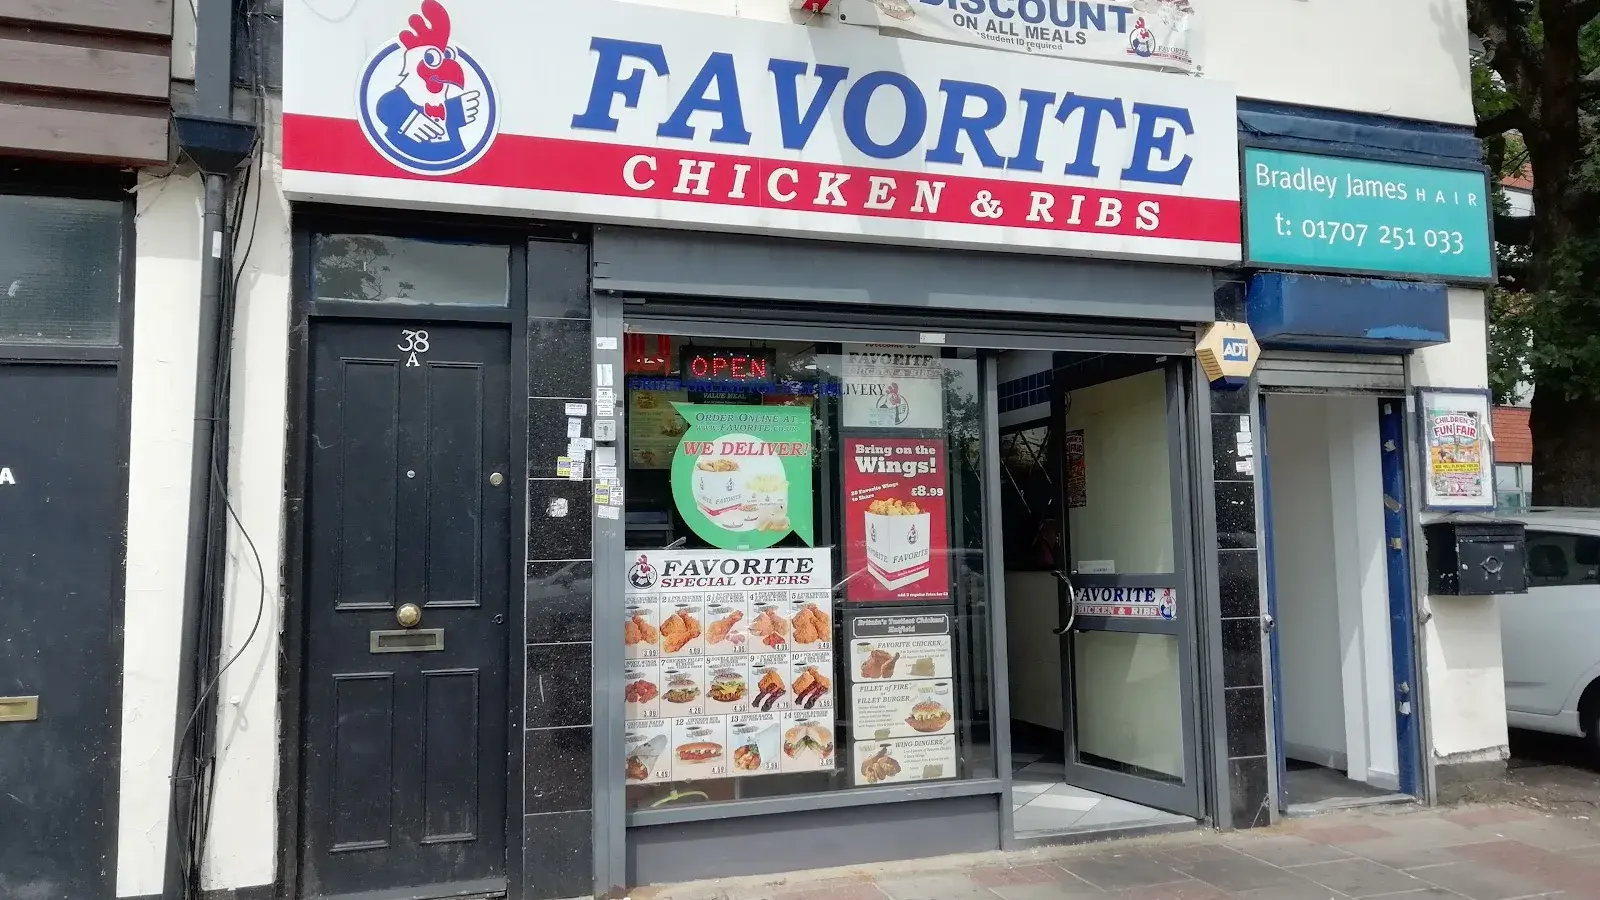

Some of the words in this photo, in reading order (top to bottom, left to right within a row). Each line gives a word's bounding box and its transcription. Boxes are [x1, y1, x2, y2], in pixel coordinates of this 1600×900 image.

[953, 13, 978, 30] ON
[985, 19, 1019, 37] ALL
[1025, 25, 1087, 45] MEALS
[1016, 38, 1025, 46] ID
[1026, 41, 1063, 51] required
[1158, 45, 1189, 57] FAVORITE
[571, 36, 1195, 186] FAVORITE
[1255, 162, 1338, 199] Bradley
[1346, 172, 1407, 200] James
[622, 154, 945, 214] CHICKEN
[970, 189, 1004, 219] &
[1027, 190, 1161, 231] RIBS
[1275, 212, 1292, 236] t:
[1302, 219, 1368, 247] 01707
[1378, 225, 1416, 251] 251
[1424, 229, 1464, 255] 033
[397, 329, 430, 352] 38
[1223, 342, 1248, 358] ADT
[406, 351, 420, 367] A
[692, 355, 766, 378] OPEN
[1434, 425, 1454, 438] FUN
[1456, 425, 1477, 438] FAIR
[684, 441, 714, 455] WE
[720, 442, 810, 456] DELIVER!
[855, 444, 892, 456] Bring
[915, 445, 936, 454] the
[855, 456, 937, 478] Wings!
[0, 467, 16, 485] A
[858, 485, 882, 494] Favorite
[859, 493, 875, 501] Share
[911, 485, 944, 497] £8.99
[893, 548, 929, 564] FAVORITE
[661, 557, 814, 577] FAVORITE
[661, 576, 736, 588] SPECIAL
[742, 574, 810, 586] OFFERS
[662, 595, 667, 603] 2
[1073, 587, 1156, 603] FAVORITE
[1131, 606, 1158, 616] RIBS
[877, 641, 910, 649] FAVORITE
[912, 640, 941, 648] CHICKEN
[792, 653, 799, 661] 10
[859, 684, 882, 692] FILLET
[885, 684, 891, 693] of
[893, 683, 909, 691] FIRE
[857, 696, 881, 704] FILLET
[883, 695, 910, 703] BURGER
